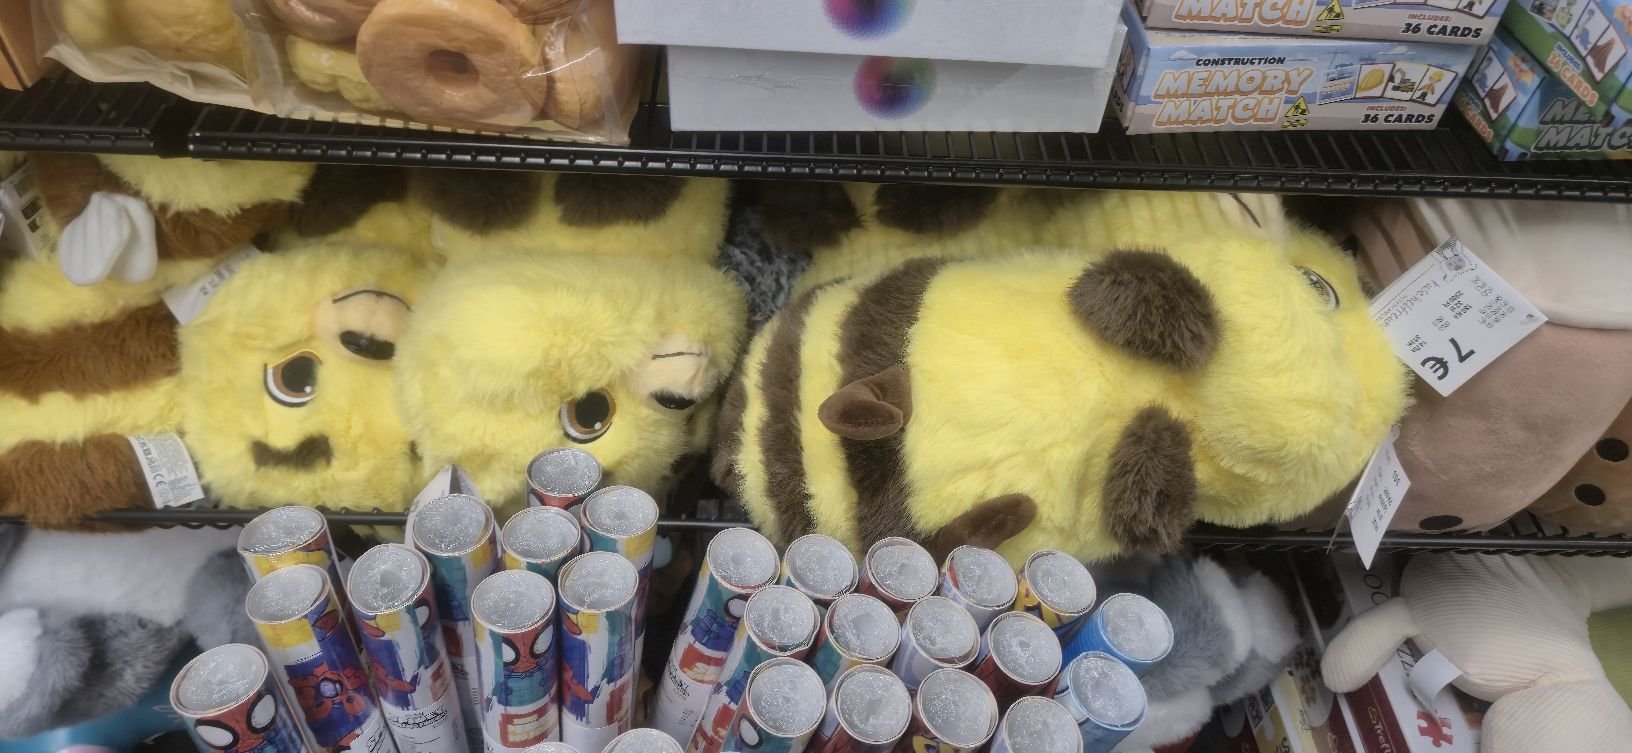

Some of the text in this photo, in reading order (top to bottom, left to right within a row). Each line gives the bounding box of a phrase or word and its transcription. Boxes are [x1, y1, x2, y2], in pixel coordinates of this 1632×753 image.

[1172, 0, 1311, 25] MATCH
[1401, 22, 1483, 39] 36 CARDS
[1196, 57, 1286, 66] CONSTRUCTION
[1155, 68, 1313, 98] MEMORY
[1561, 62, 1599, 107] CARDS
[1154, 97, 1283, 127] MATCH
[1361, 114, 1435, 125] 36 CARDS
[1531, 124, 1632, 152] MATC
